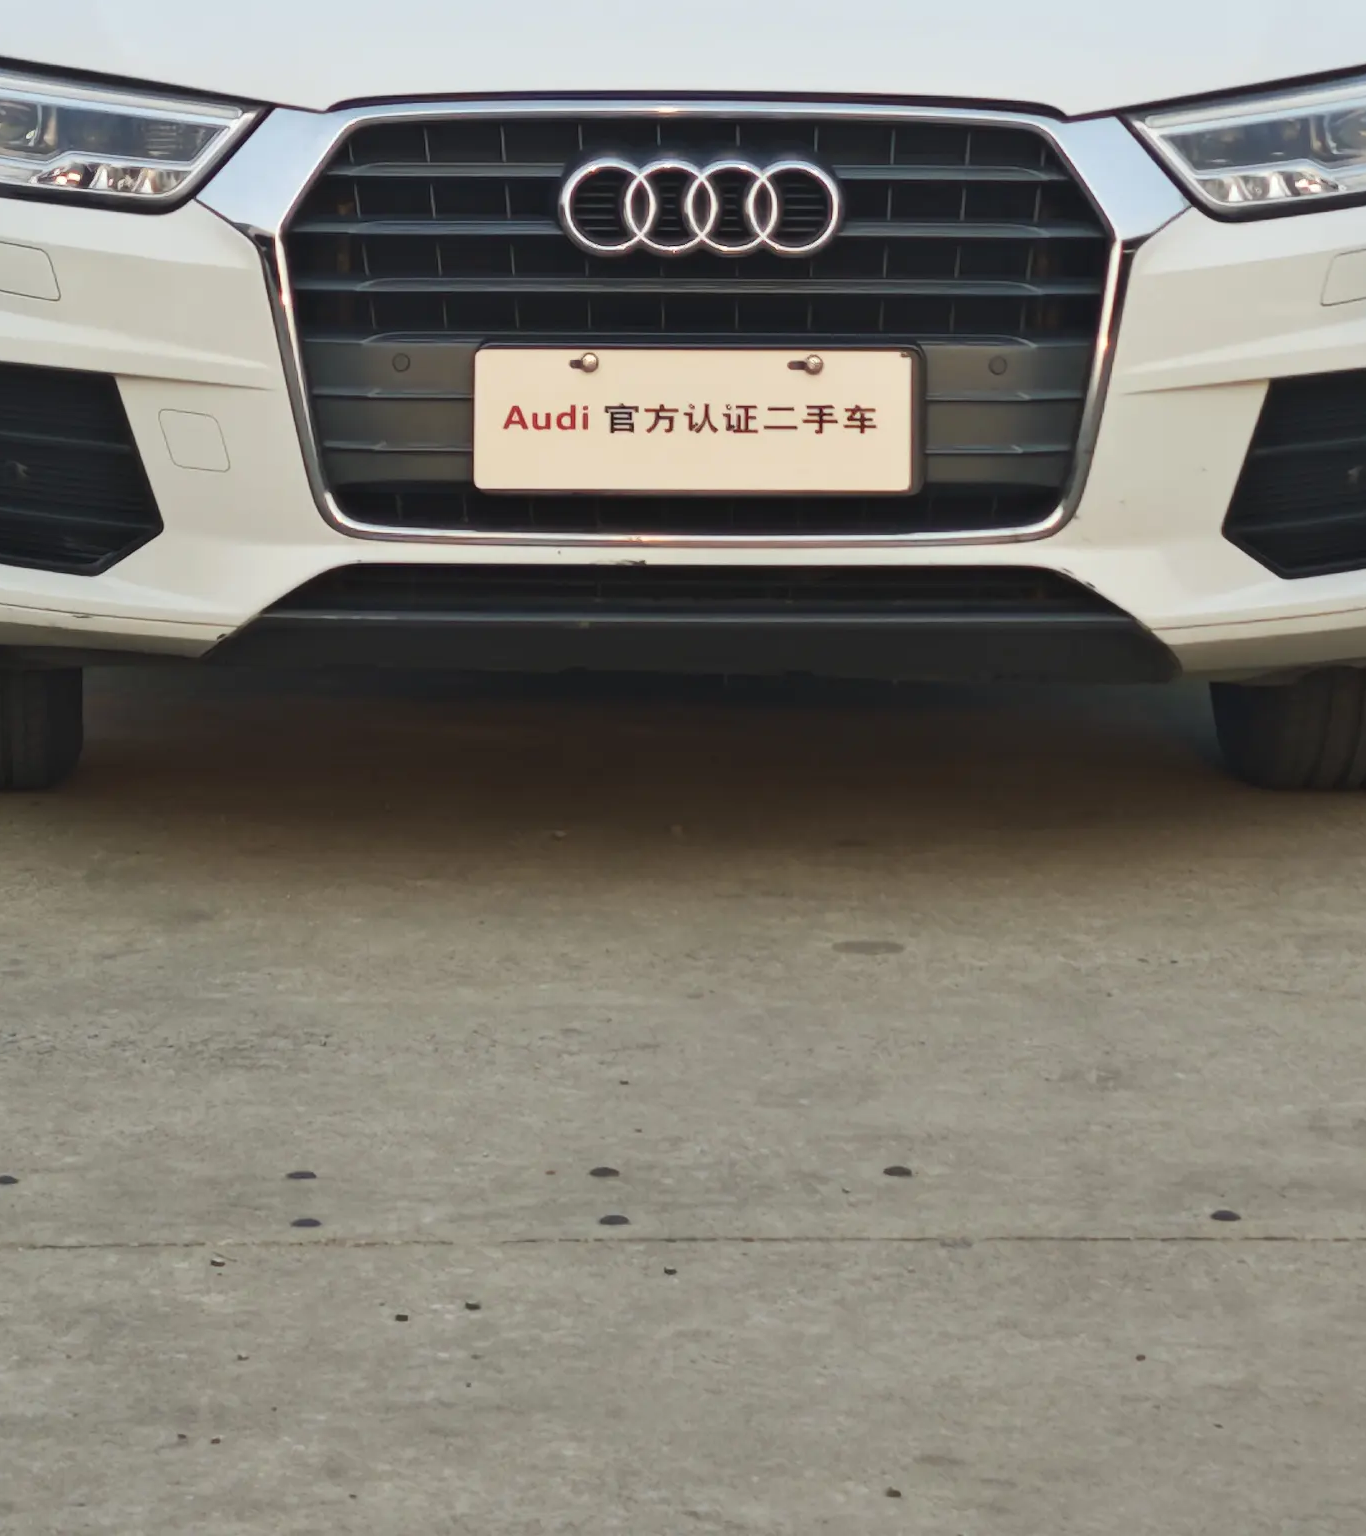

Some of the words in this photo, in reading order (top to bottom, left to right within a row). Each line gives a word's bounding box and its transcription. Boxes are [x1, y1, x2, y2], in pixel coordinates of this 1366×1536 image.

[503, 405, 590, 431] Audi
[605, 404, 878, 434] 官方认证二手车
